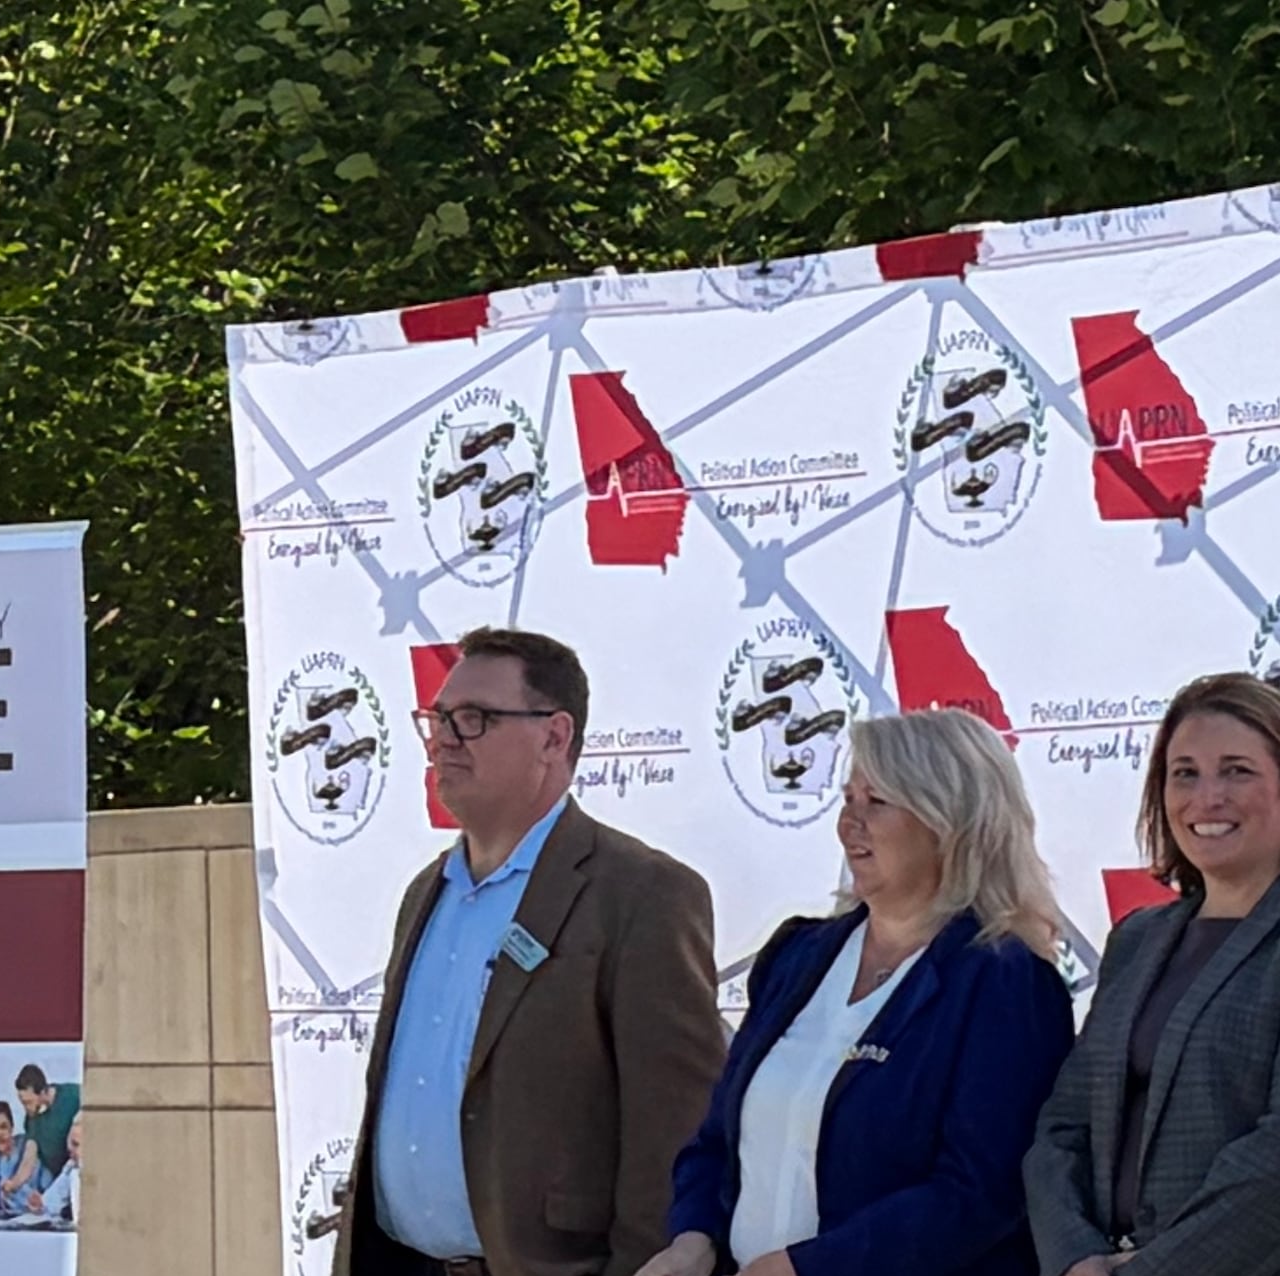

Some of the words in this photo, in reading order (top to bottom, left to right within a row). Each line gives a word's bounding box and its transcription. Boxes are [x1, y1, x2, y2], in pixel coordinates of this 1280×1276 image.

[1098, 405, 1188, 442] UAPRN
[1227, 401, 1280, 425] Political
[701, 461, 747, 482] Political
[750, 457, 787, 478] Action
[789, 451, 860, 474] Committee
[1030, 698, 1083, 723] Political
[1086, 697, 1128, 719] Action
[618, 726, 683, 749] Committee
